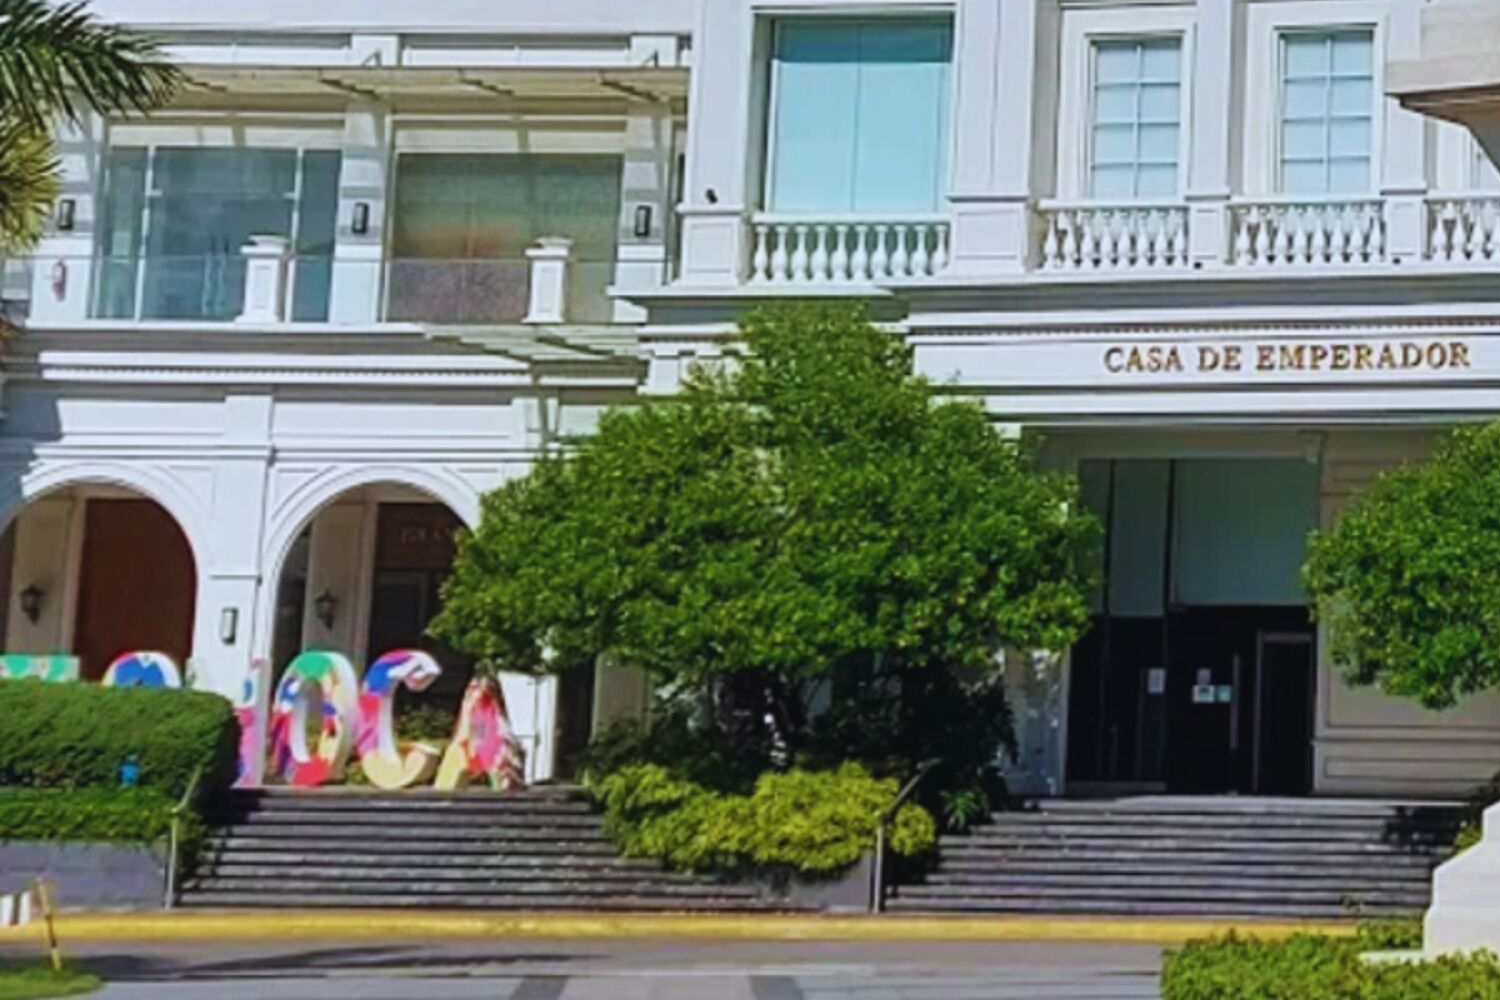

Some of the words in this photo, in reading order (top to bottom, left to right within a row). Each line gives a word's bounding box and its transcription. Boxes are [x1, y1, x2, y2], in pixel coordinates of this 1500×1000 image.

[1104, 345, 1184, 373] CASA
[1197, 346, 1243, 371] DE
[1256, 341, 1471, 371] EMPERADOR
